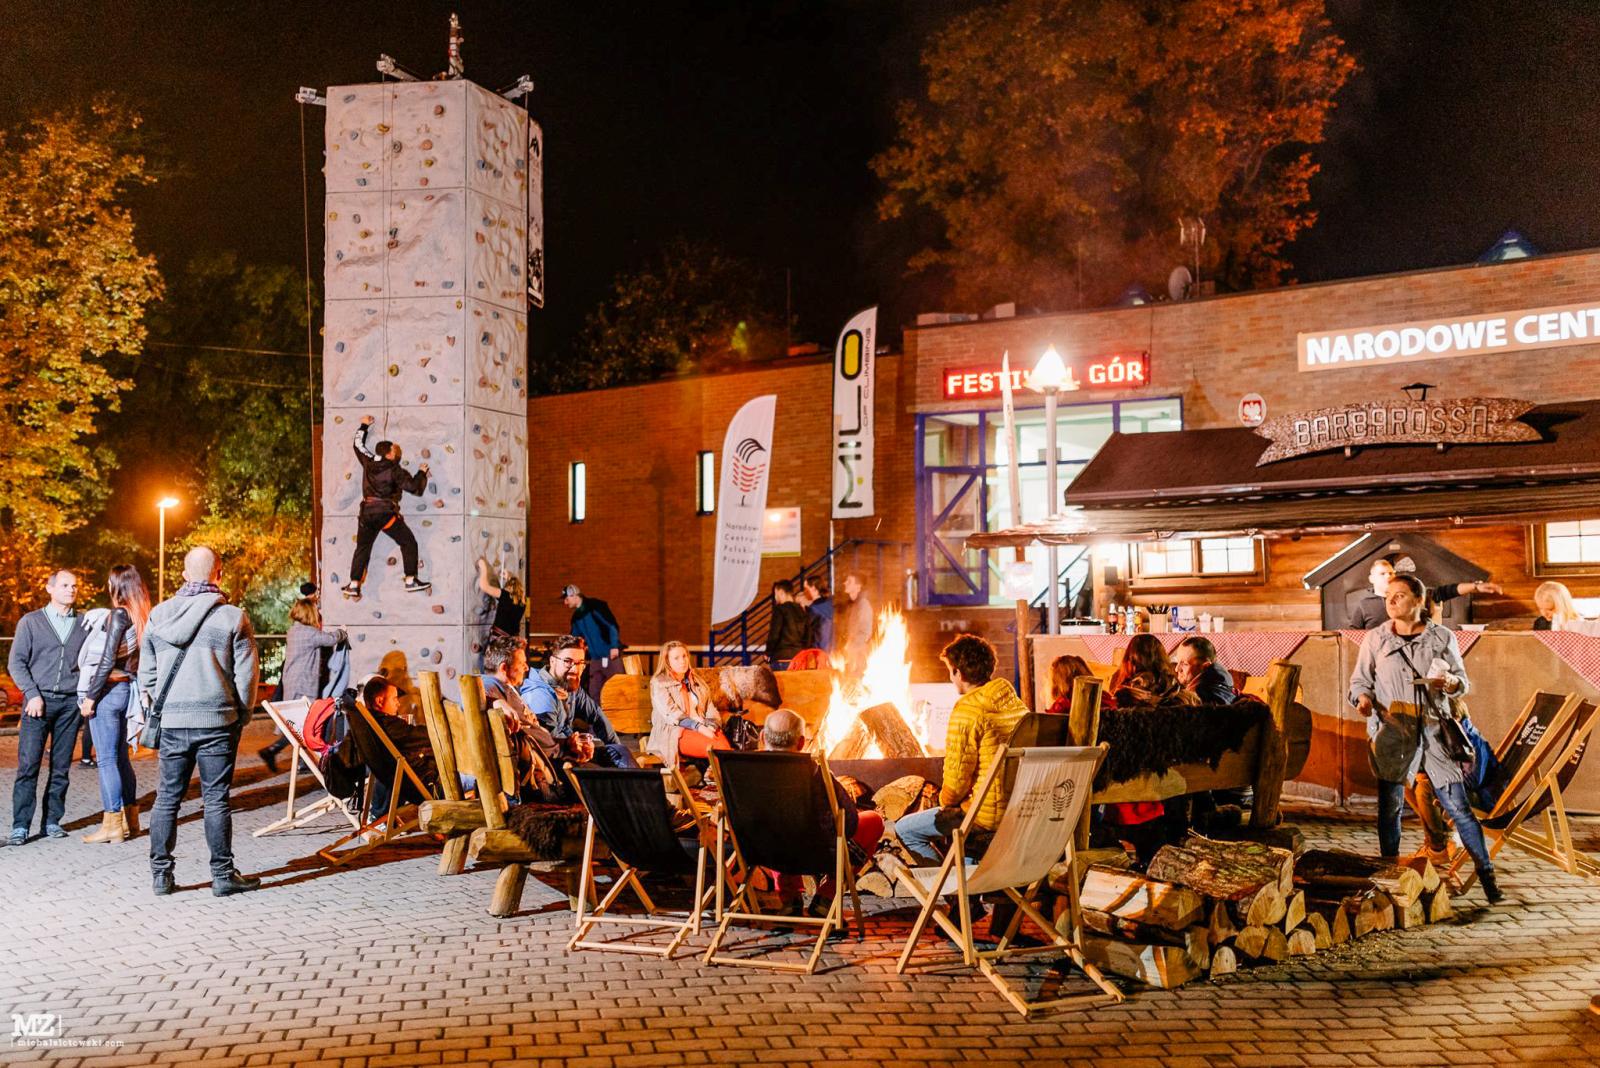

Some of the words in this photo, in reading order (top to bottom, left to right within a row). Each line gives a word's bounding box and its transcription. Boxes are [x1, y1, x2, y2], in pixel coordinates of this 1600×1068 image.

[1306, 318, 1507, 365] NARODOWE
[947, 366, 1078, 395] FESTIL
[1089, 356, 1144, 384] GÓR
[1294, 405, 1488, 447] BARBAROSSA
